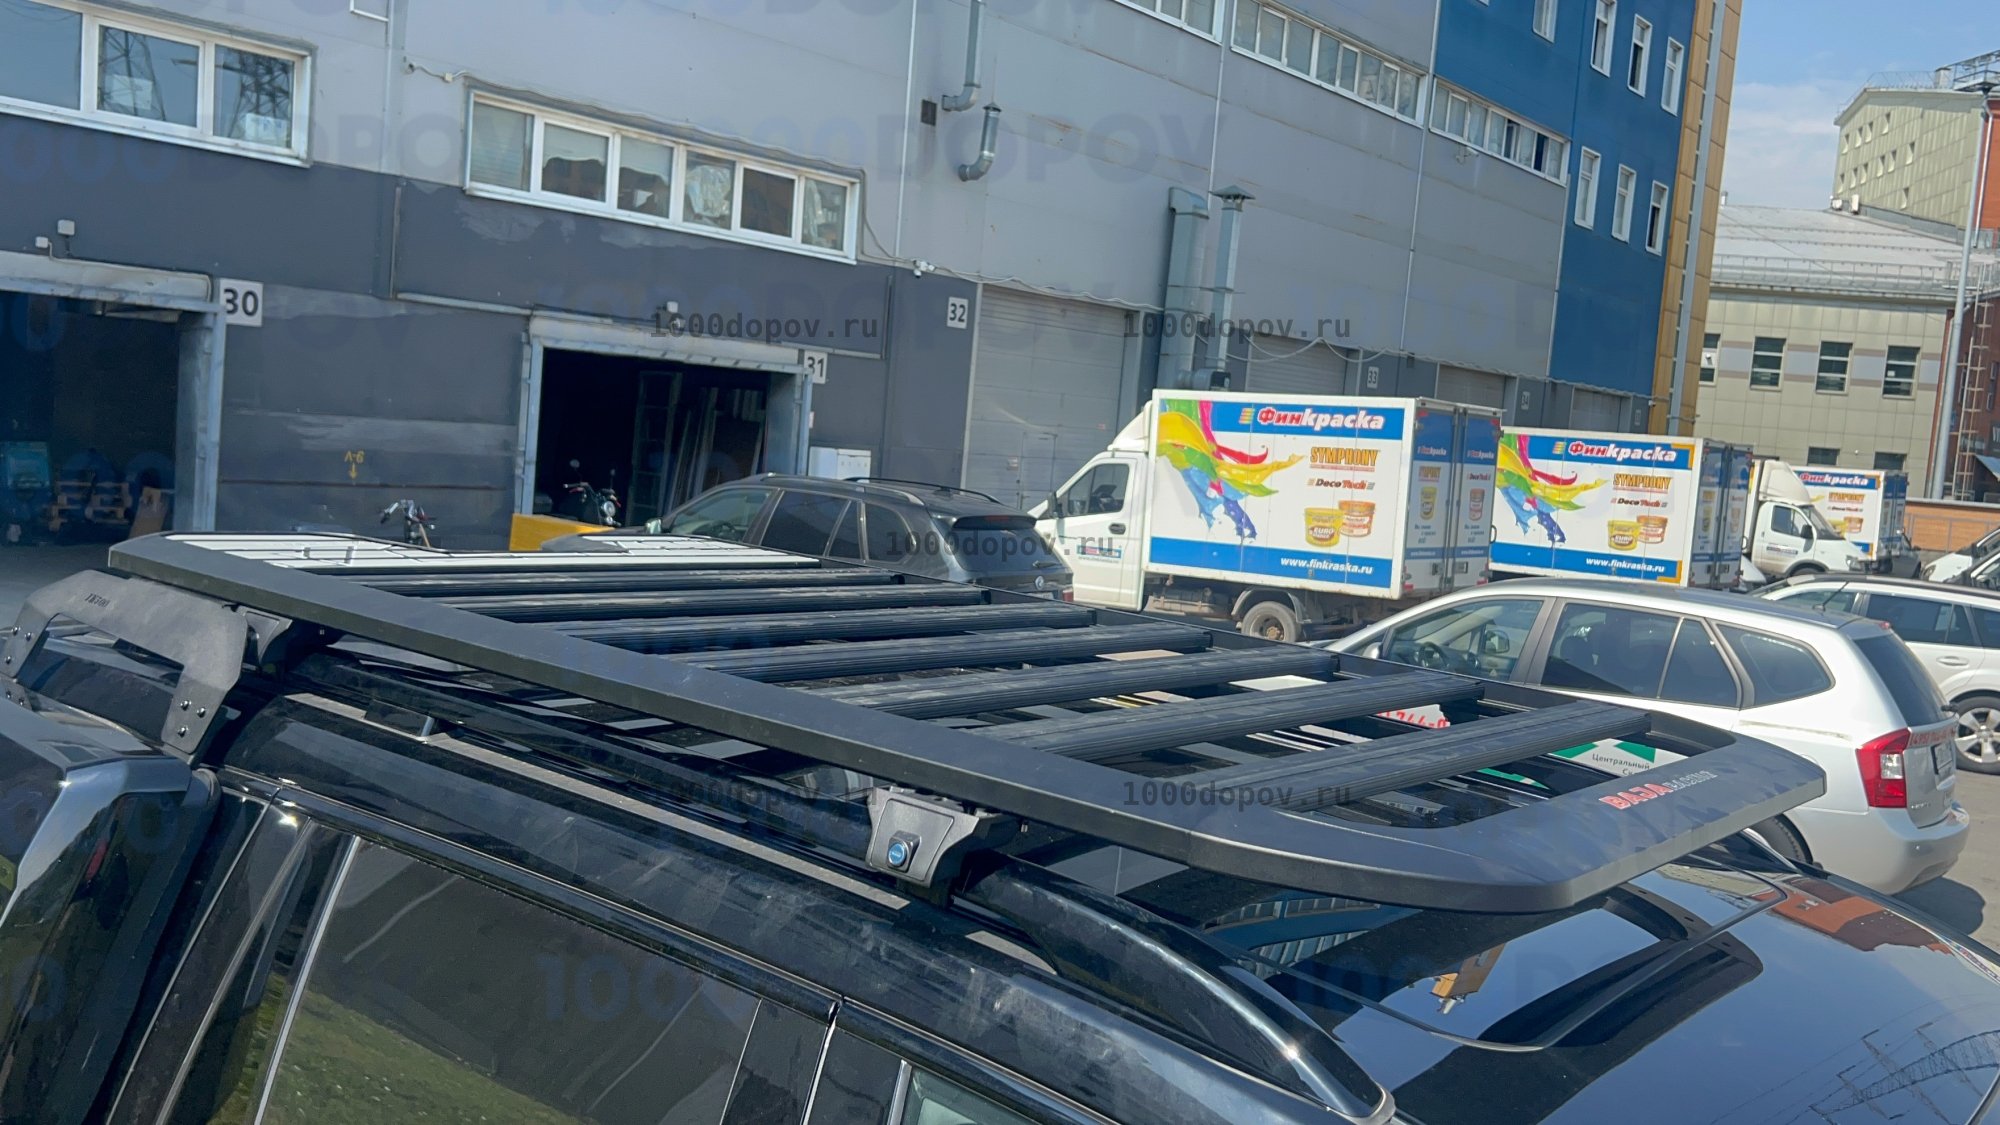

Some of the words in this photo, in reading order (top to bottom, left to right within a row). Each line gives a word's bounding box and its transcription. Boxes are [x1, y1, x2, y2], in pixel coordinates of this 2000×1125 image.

[223, 287, 259, 317] 30
[949, 303, 966, 323] 32
[807, 356, 825, 378] 31
[1368, 370, 1378, 385] 33
[1310, 446, 1380, 467] SYMPHONY
[1613, 473, 1673, 490] SYMPHONY
[1280, 557, 1374, 575] www.finkraska.ru
[1585, 557, 1665, 573] www.finkraska.ru
[1592, 753, 1650, 770] Центральный
[1598, 783, 1674, 810] BAJA
